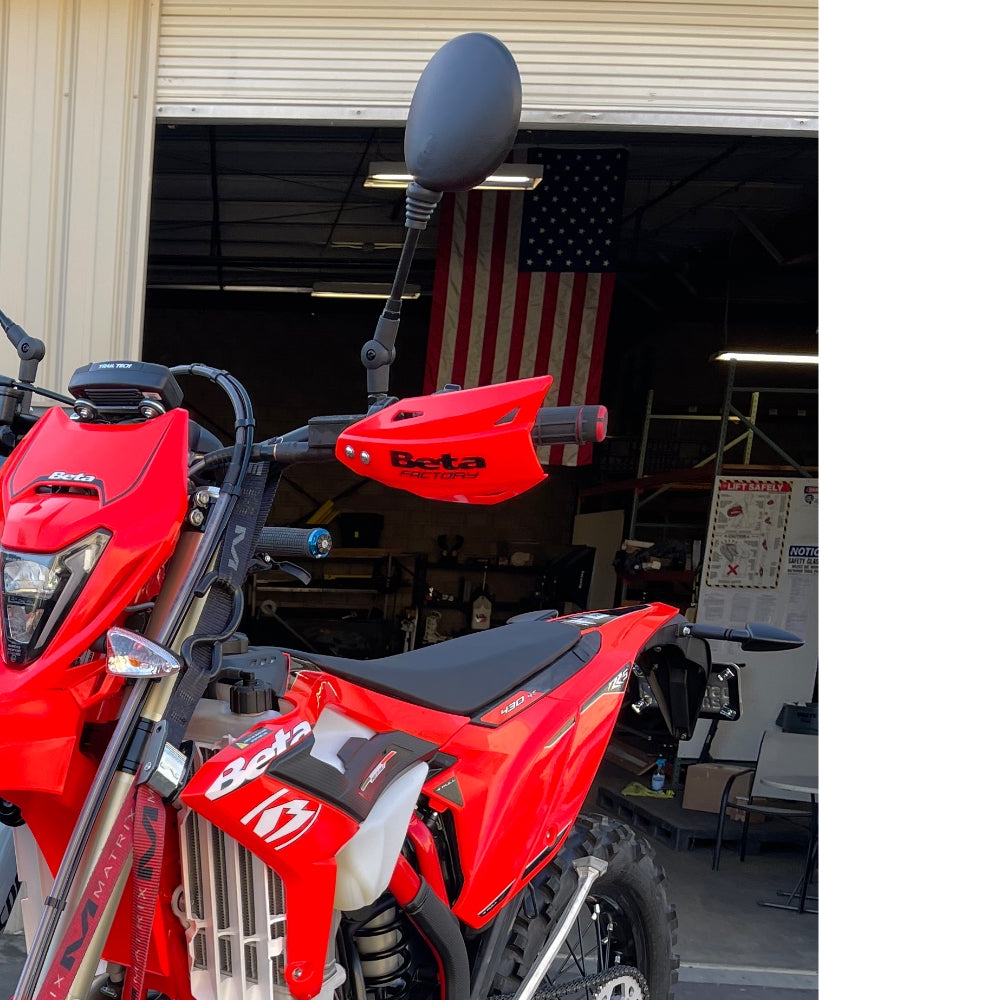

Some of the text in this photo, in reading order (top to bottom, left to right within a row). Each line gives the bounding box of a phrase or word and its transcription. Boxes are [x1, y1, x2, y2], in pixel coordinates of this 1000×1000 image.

[390, 450, 486, 470] Beta
[47, 471, 96, 483] Beta
[399, 470, 480, 480] FACTORY
[727, 483, 784, 492] LIFT SAFELY
[790, 547, 818, 556] NOTIC
[500, 696, 525, 715] 430
[204, 720, 312, 801] Beta
[93, 807, 136, 898] MATRIX
